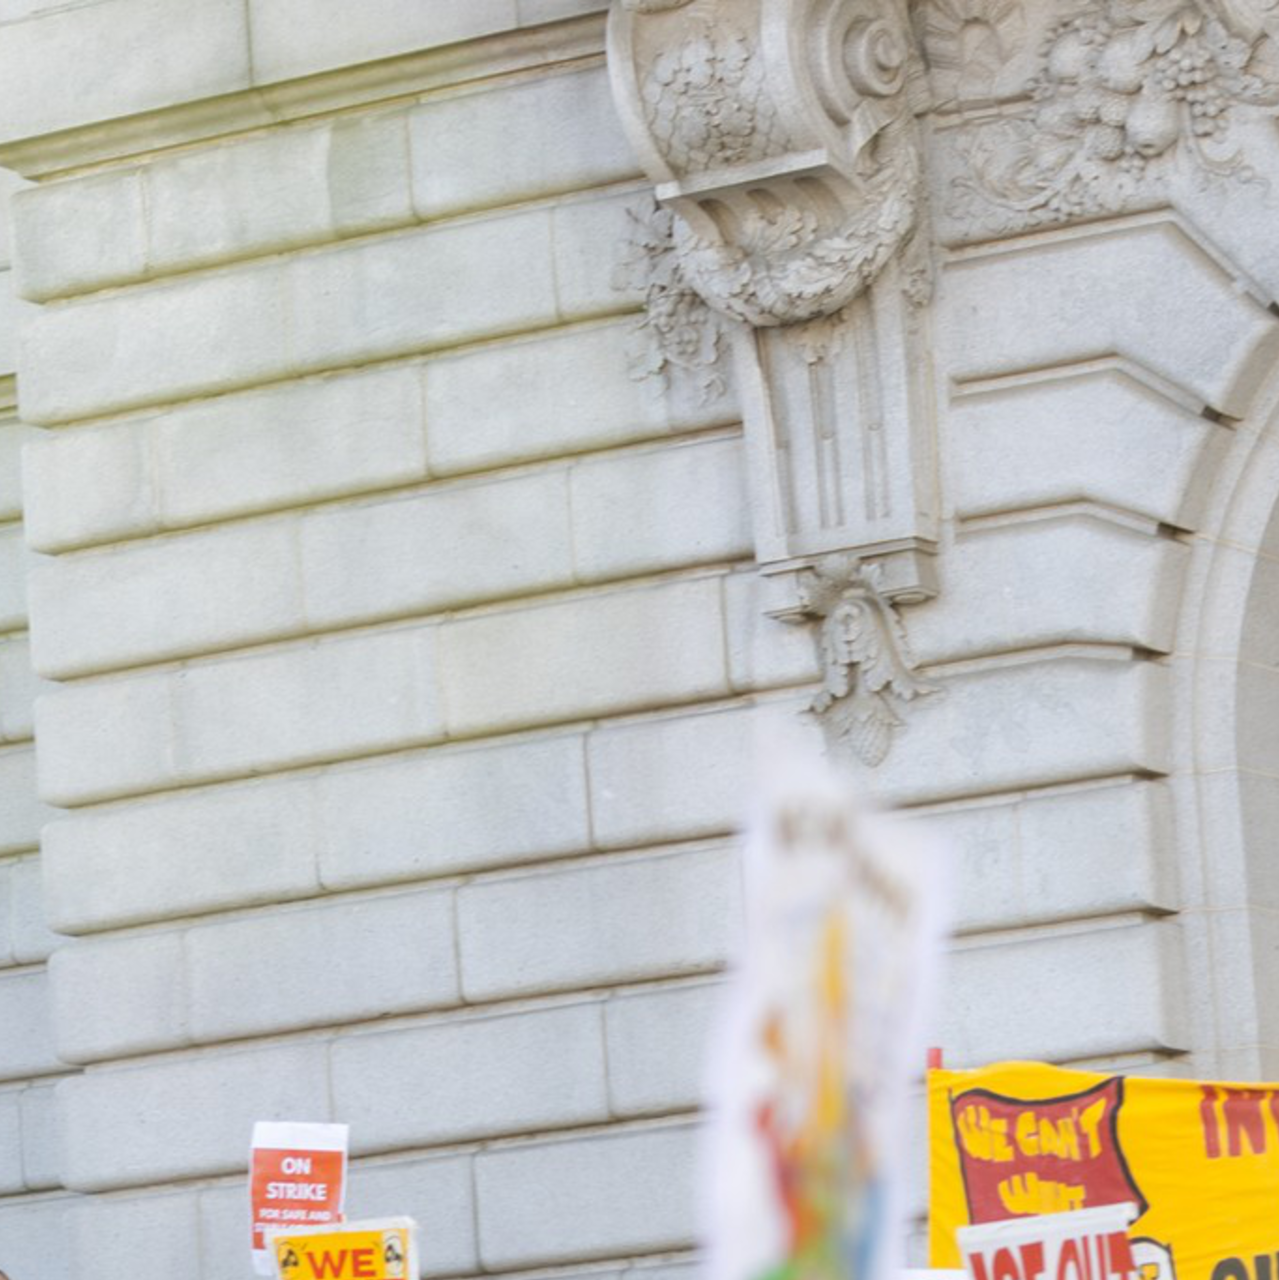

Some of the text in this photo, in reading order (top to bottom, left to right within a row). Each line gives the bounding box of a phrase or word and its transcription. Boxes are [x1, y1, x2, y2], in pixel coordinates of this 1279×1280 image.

[957, 1097, 1107, 1163] WE CAN'T
[281, 1157, 311, 1175] ON
[265, 1182, 327, 1201] STRIKE
[259, 1208, 331, 1221] FOR SAFE AND
[306, 1249, 376, 1280] WE
